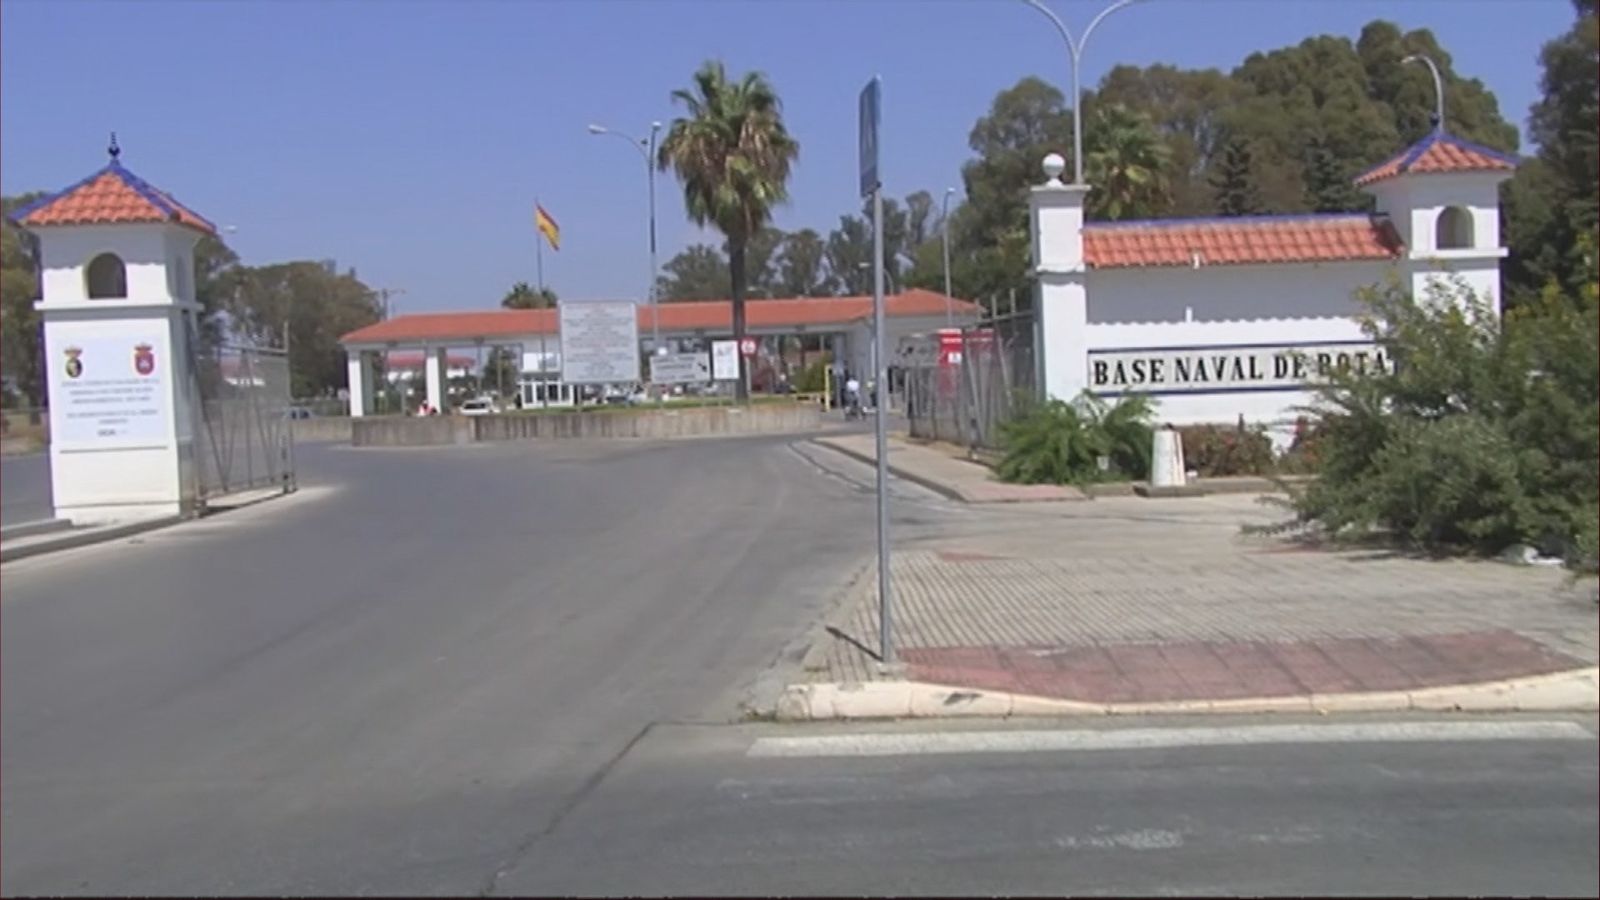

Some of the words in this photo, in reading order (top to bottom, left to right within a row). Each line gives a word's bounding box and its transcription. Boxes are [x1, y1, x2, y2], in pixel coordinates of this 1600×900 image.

[1094, 359, 1164, 385] BASE
[1175, 356, 1262, 382] NAVAL
[1274, 353, 1307, 379] DE
